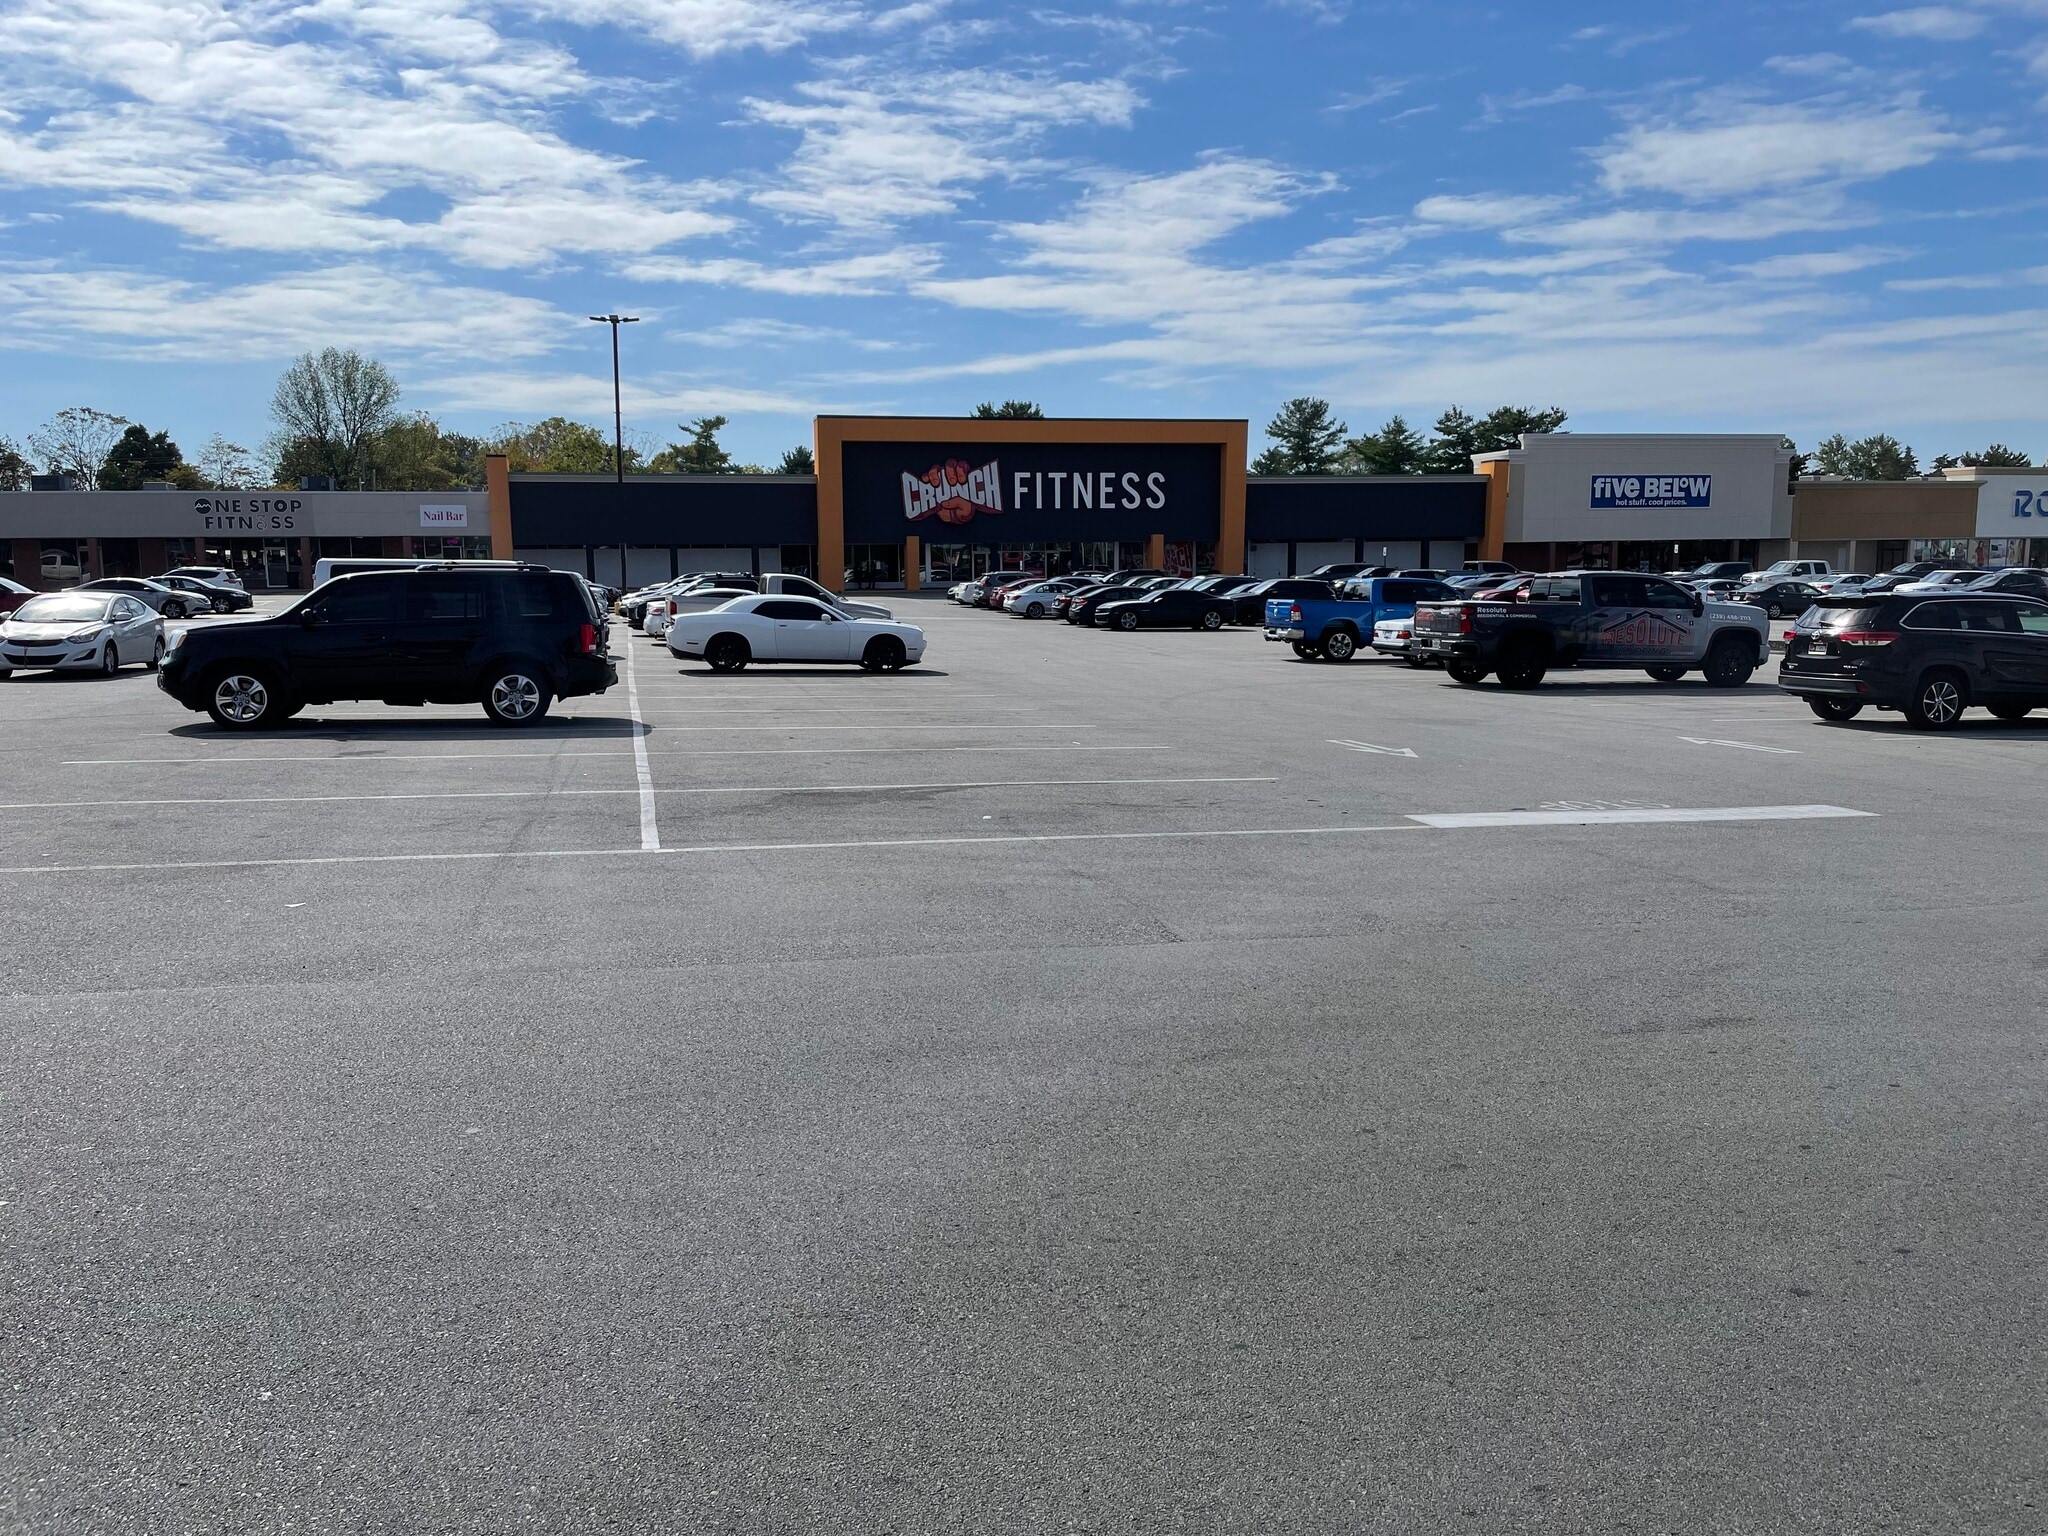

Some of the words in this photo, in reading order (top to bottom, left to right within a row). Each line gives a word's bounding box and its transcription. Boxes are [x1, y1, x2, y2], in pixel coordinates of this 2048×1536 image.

[902, 461, 1002, 519] CRUNCH
[1014, 471, 1166, 510] FITNESS
[1593, 477, 1641, 498] five
[1644, 477, 1711, 498] BELOW
[249, 499, 302, 513] STOP
[1615, 498, 1628, 506] hot
[1628, 498, 1648, 506] stuff.
[1648, 498, 1664, 506] cool
[1664, 499, 1688, 507] prices.
[423, 510, 444, 521] Nail
[446, 511, 464, 521] Bar
[1603, 618, 1687, 645] RESOLUTE
